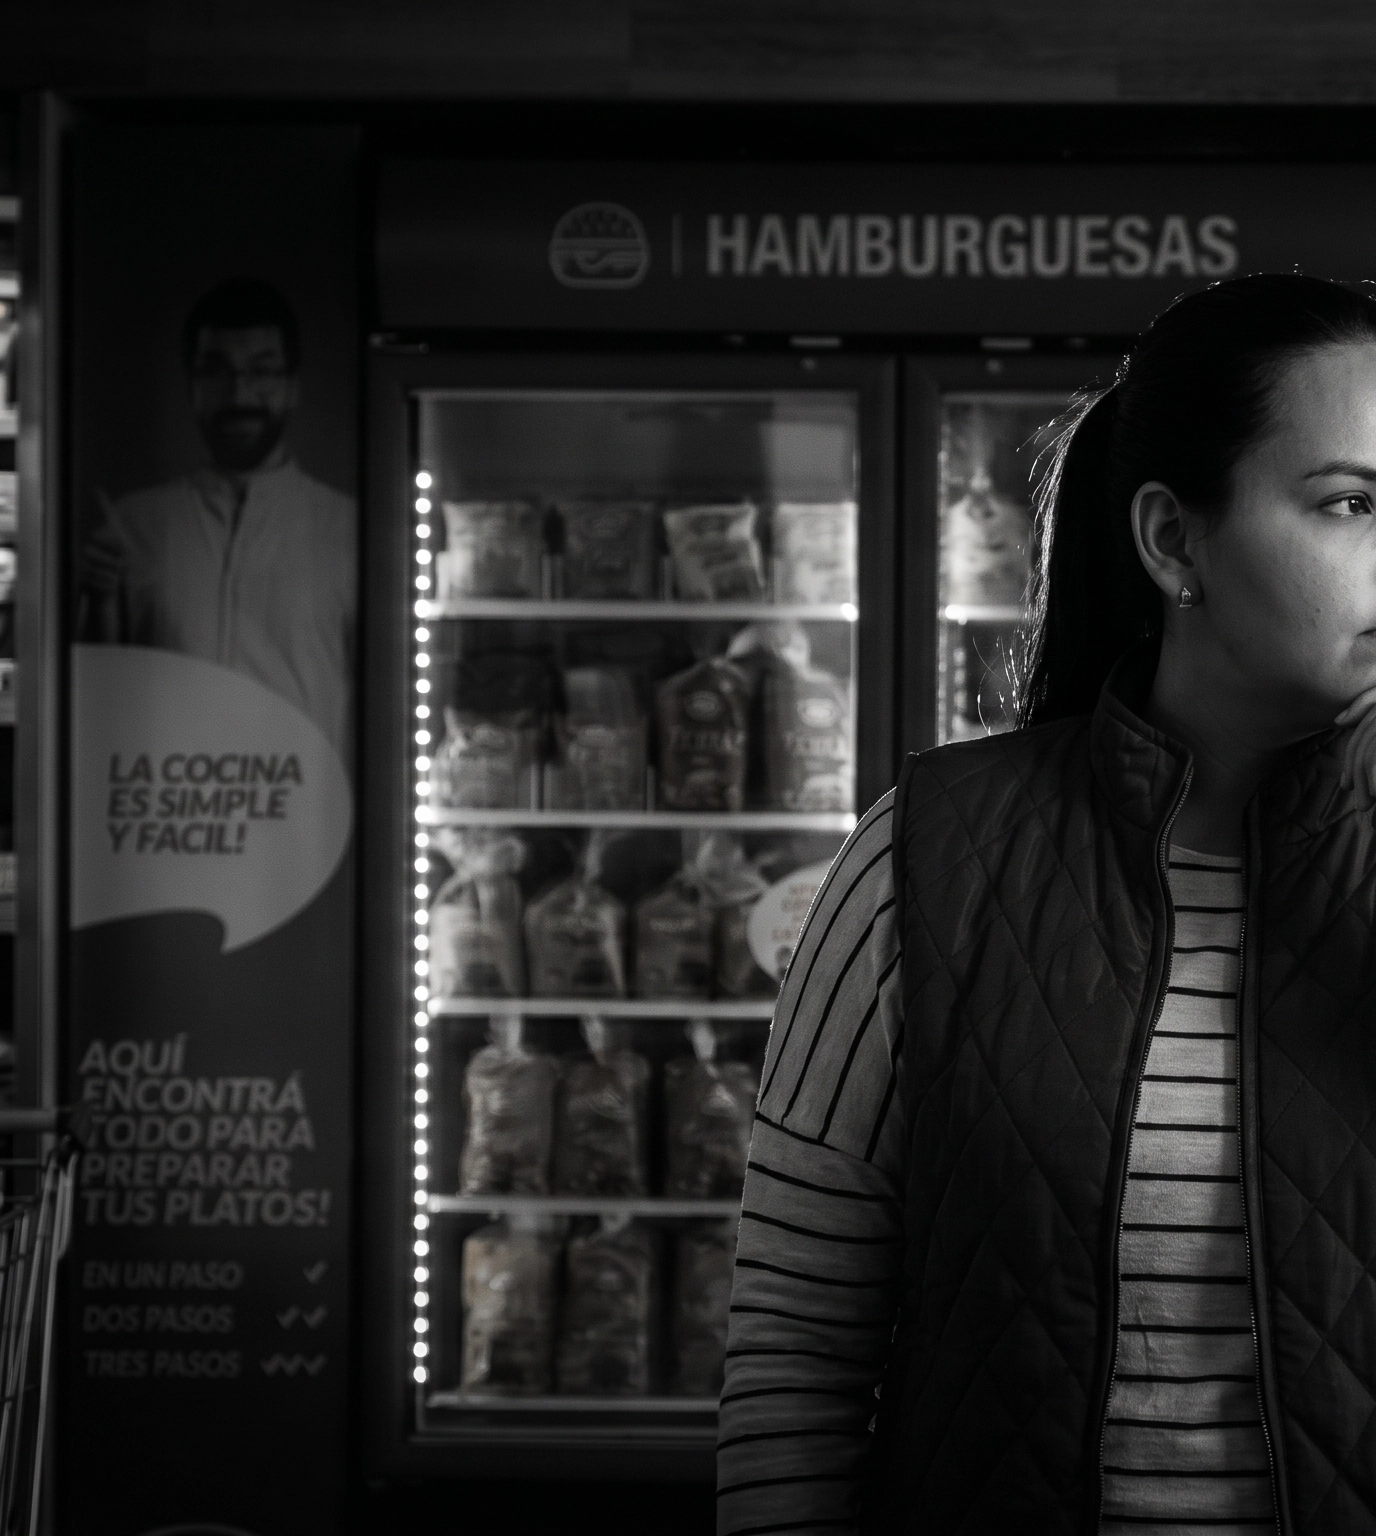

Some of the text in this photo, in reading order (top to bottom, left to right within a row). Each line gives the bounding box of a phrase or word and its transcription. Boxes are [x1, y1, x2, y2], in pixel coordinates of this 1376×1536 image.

[707, 213, 1240, 278] HAMBURGUESAS
[108, 752, 302, 785] LA COCINA
[107, 788, 289, 819] ES SIMPLE
[108, 823, 247, 855] Y FACIL!
[78, 1032, 188, 1082] AQUÍ
[82, 1071, 307, 1114] ENCONTRÁ
[206, 1115, 316, 1151] PARA
[80, 1152, 291, 1188] PREPARAR
[80, 1188, 332, 1227] TUS PLATOS!
[82, 1260, 245, 1290] EN UN PASO
[82, 1304, 235, 1334] DOS PASOS
[83, 1350, 244, 1379] TRES PASOS
